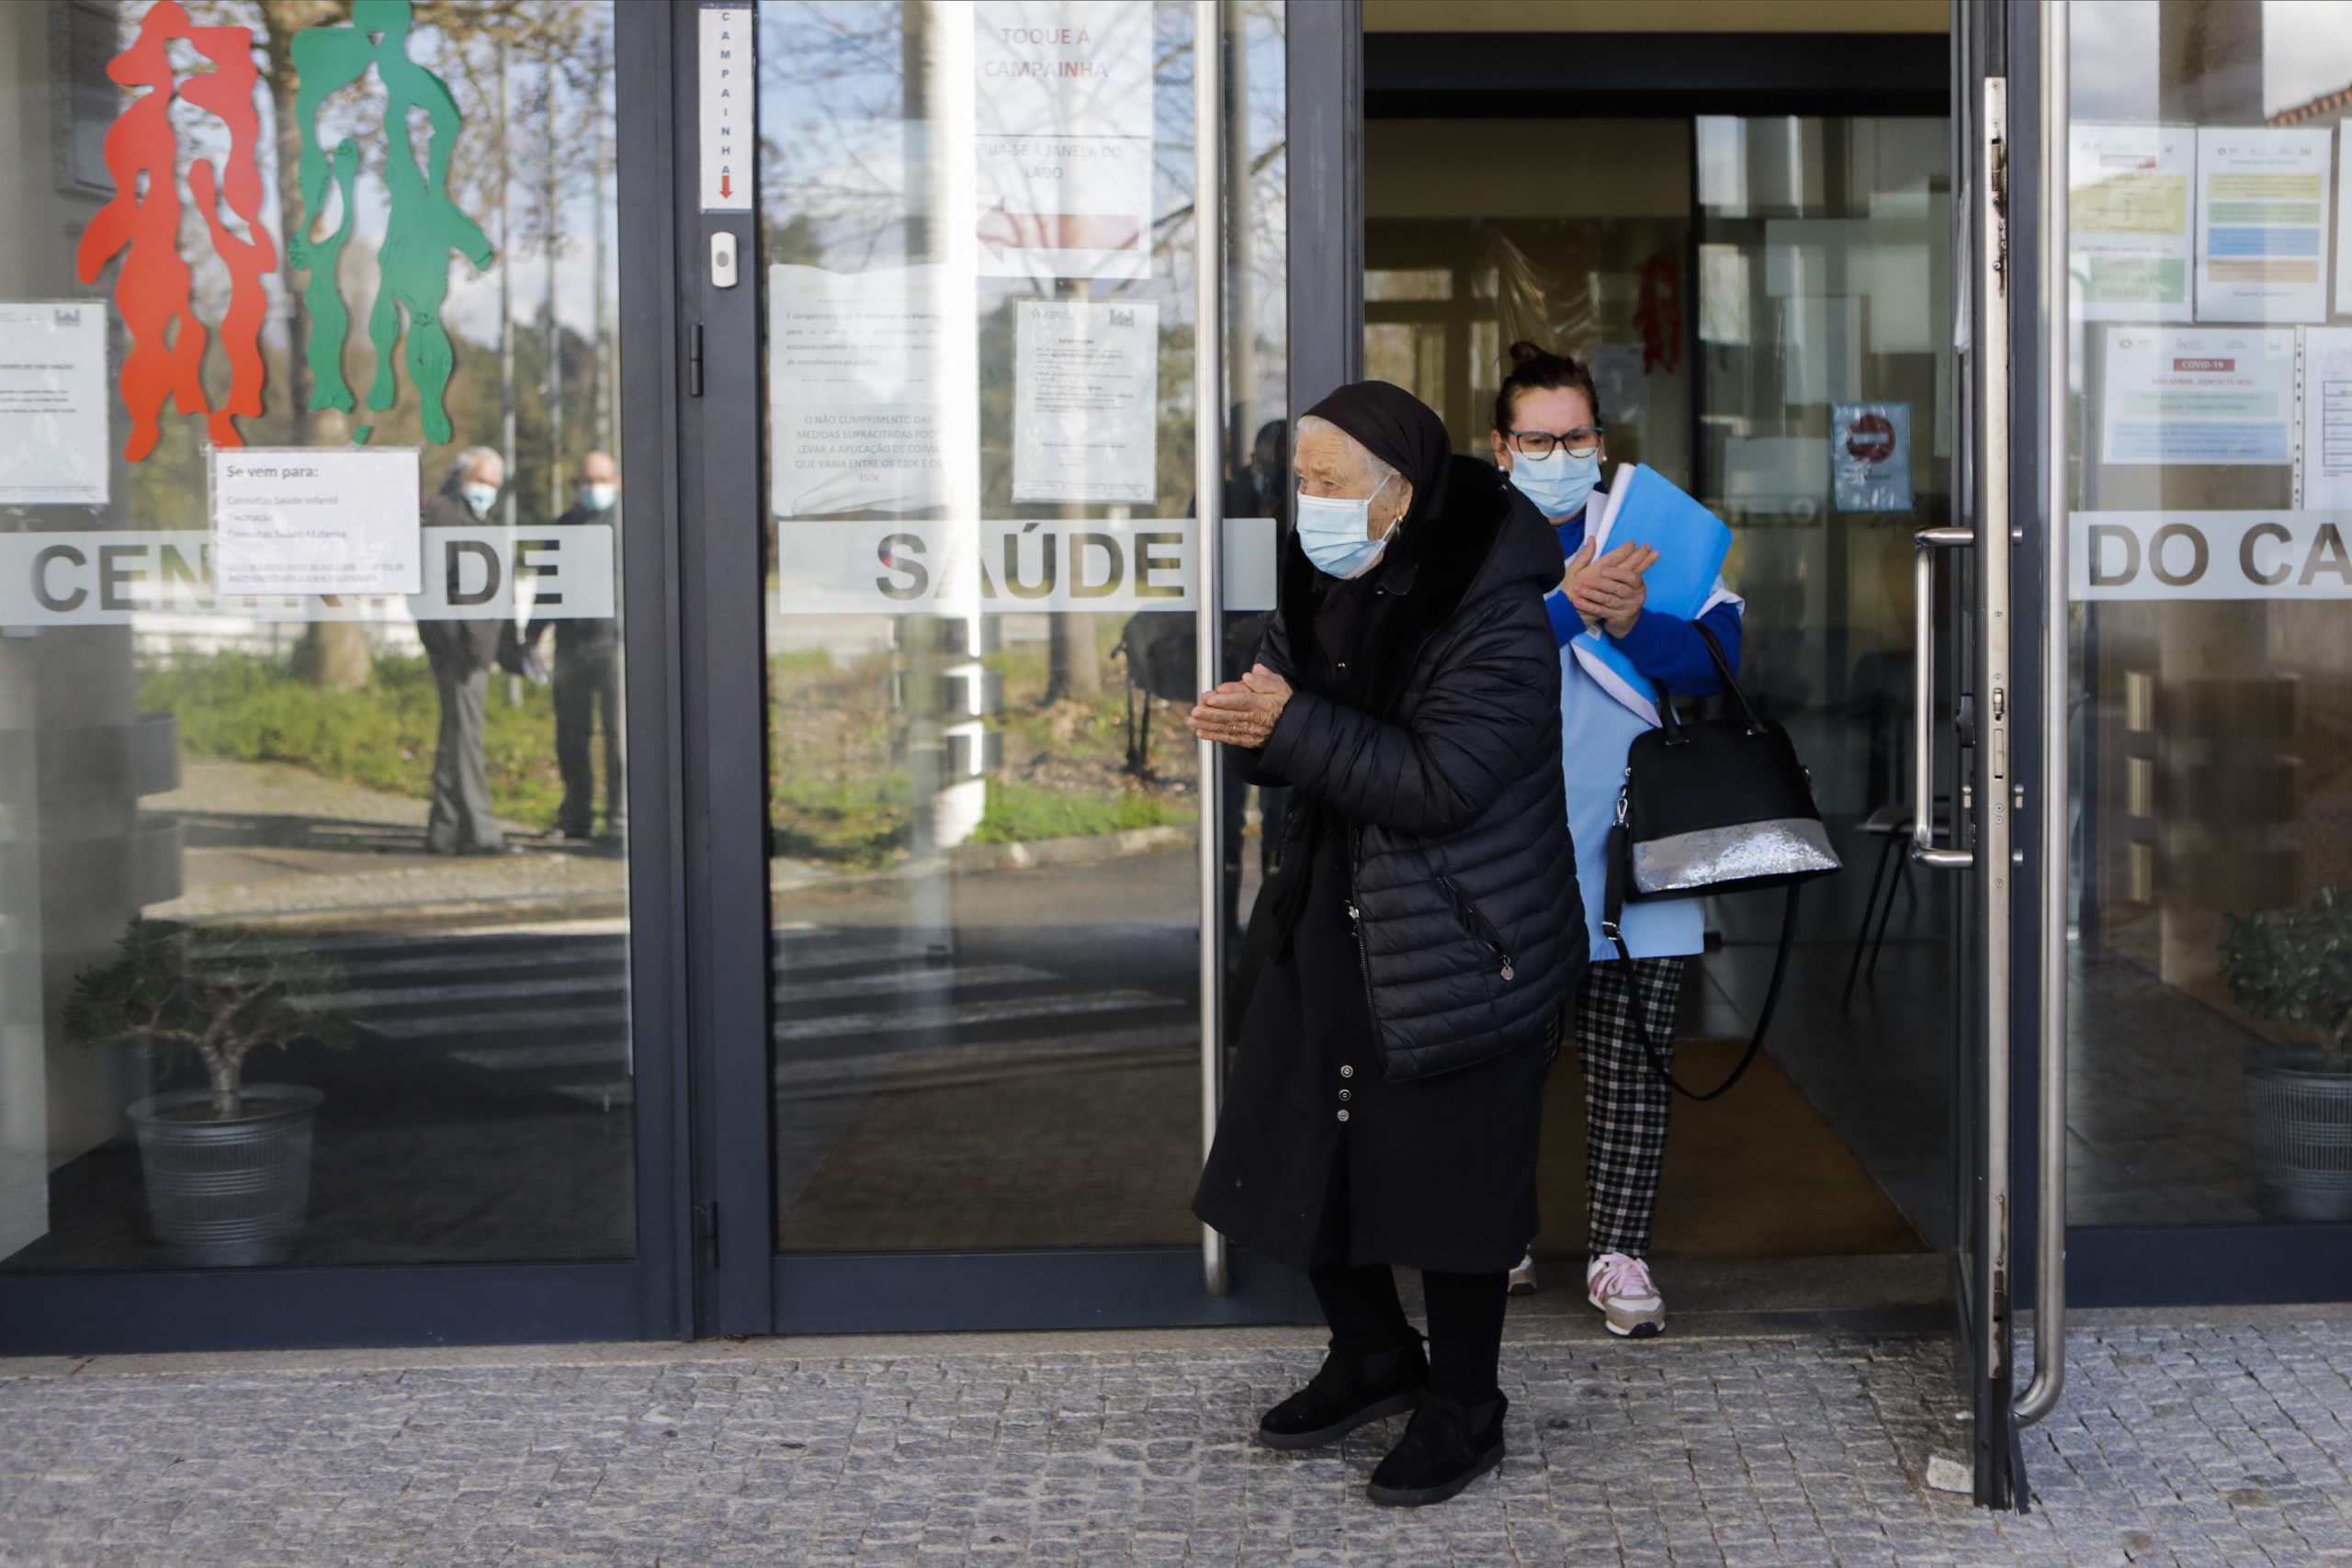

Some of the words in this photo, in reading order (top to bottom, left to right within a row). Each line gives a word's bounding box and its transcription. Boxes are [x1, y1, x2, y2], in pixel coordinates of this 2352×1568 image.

[1001, 28, 1071, 45] TOQUE
[984, 61, 1109, 78] CAMPAINHA
[720, 11, 731, 175] CAMPAINHA
[1046, 145, 1097, 157] JANELA
[1102, 146, 1124, 158] DO
[1024, 167, 1064, 179] LADO
[2181, 360, 2224, 369] COVID-19
[815, 413, 836, 424] NÃO
[838, 415, 911, 424] CUMPRIMENTO
[913, 415, 933, 424] DAS
[797, 430, 840, 439] MEDIDAS
[842, 430, 912, 439] SUPRACITADAS
[797, 445, 827, 454] LEVAR
[838, 443, 890, 455] APLICAÇÃO
[893, 445, 904, 454] DE
[795, 458, 815, 469] QUE
[818, 459, 846, 468] VARIA
[849, 459, 878, 468] ENTRE
[881, 459, 894, 468] OS
[227, 466, 243, 478] Se
[246, 468, 277, 478] vem
[282, 467, 319, 479] para:
[2087, 523, 2210, 586] DO
[2239, 522, 2352, 586] CA
[446, 539, 562, 605] DE
